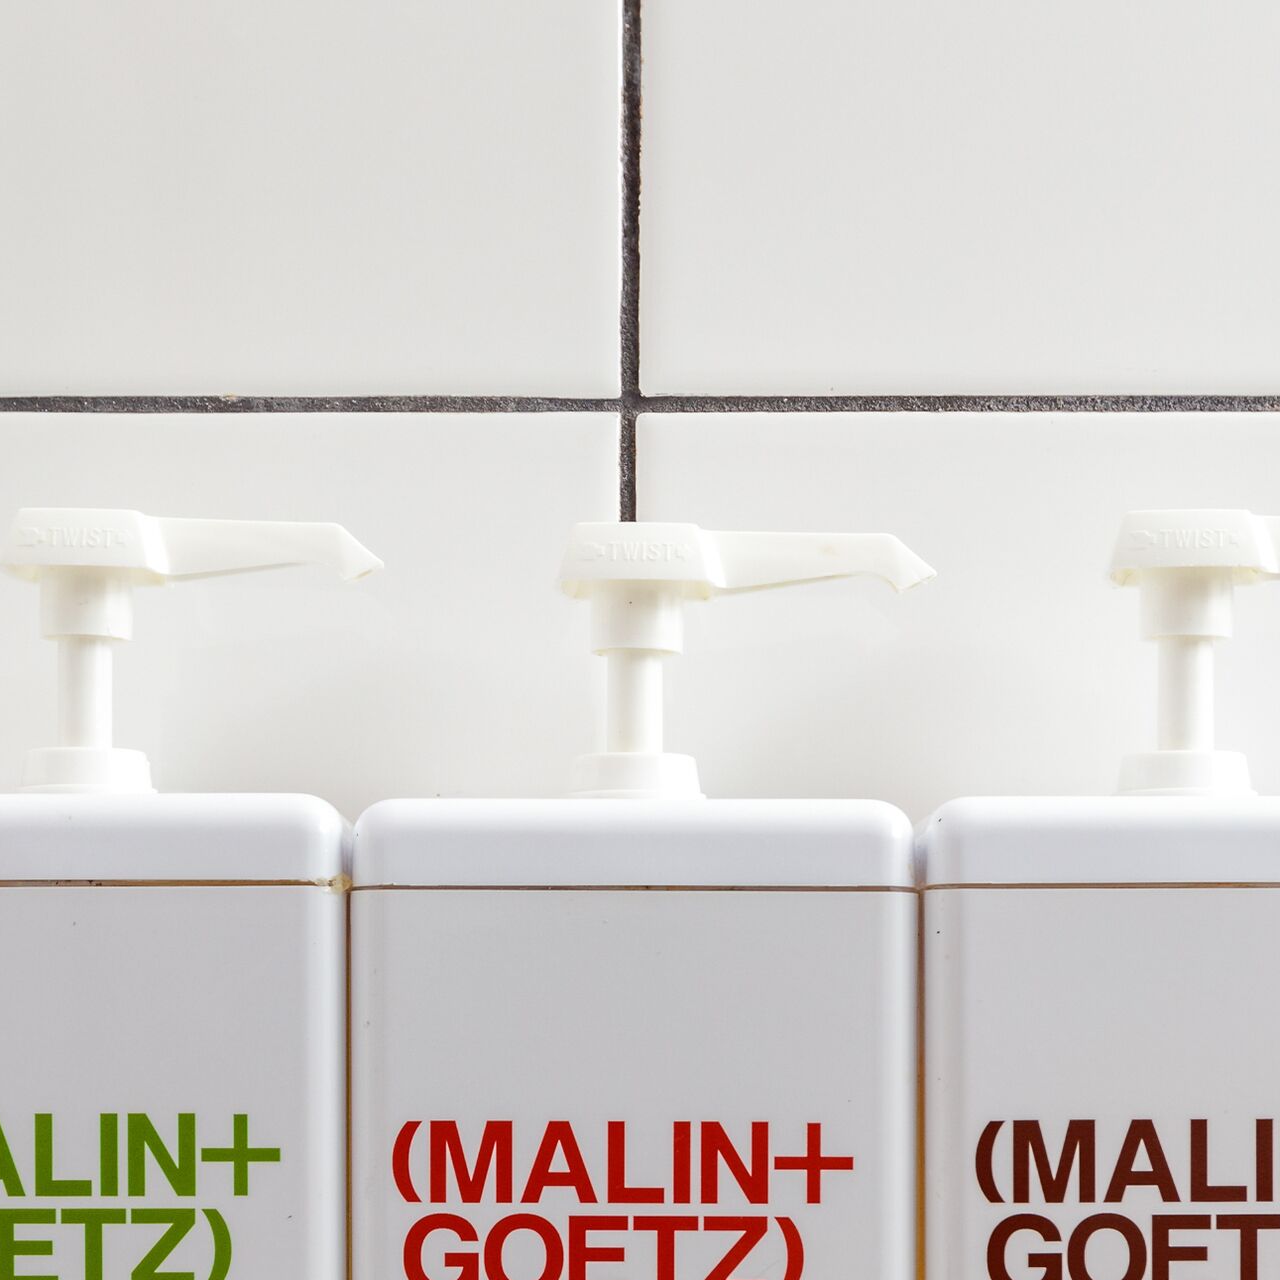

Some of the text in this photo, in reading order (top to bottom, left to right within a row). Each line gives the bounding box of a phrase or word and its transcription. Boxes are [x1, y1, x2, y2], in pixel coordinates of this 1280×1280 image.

[47, 527, 116, 548] TWIST
[1159, 528, 1231, 549] TWIST
[607, 541, 675, 562] TWIST
[391, 1119, 855, 1205] (MALIN+
